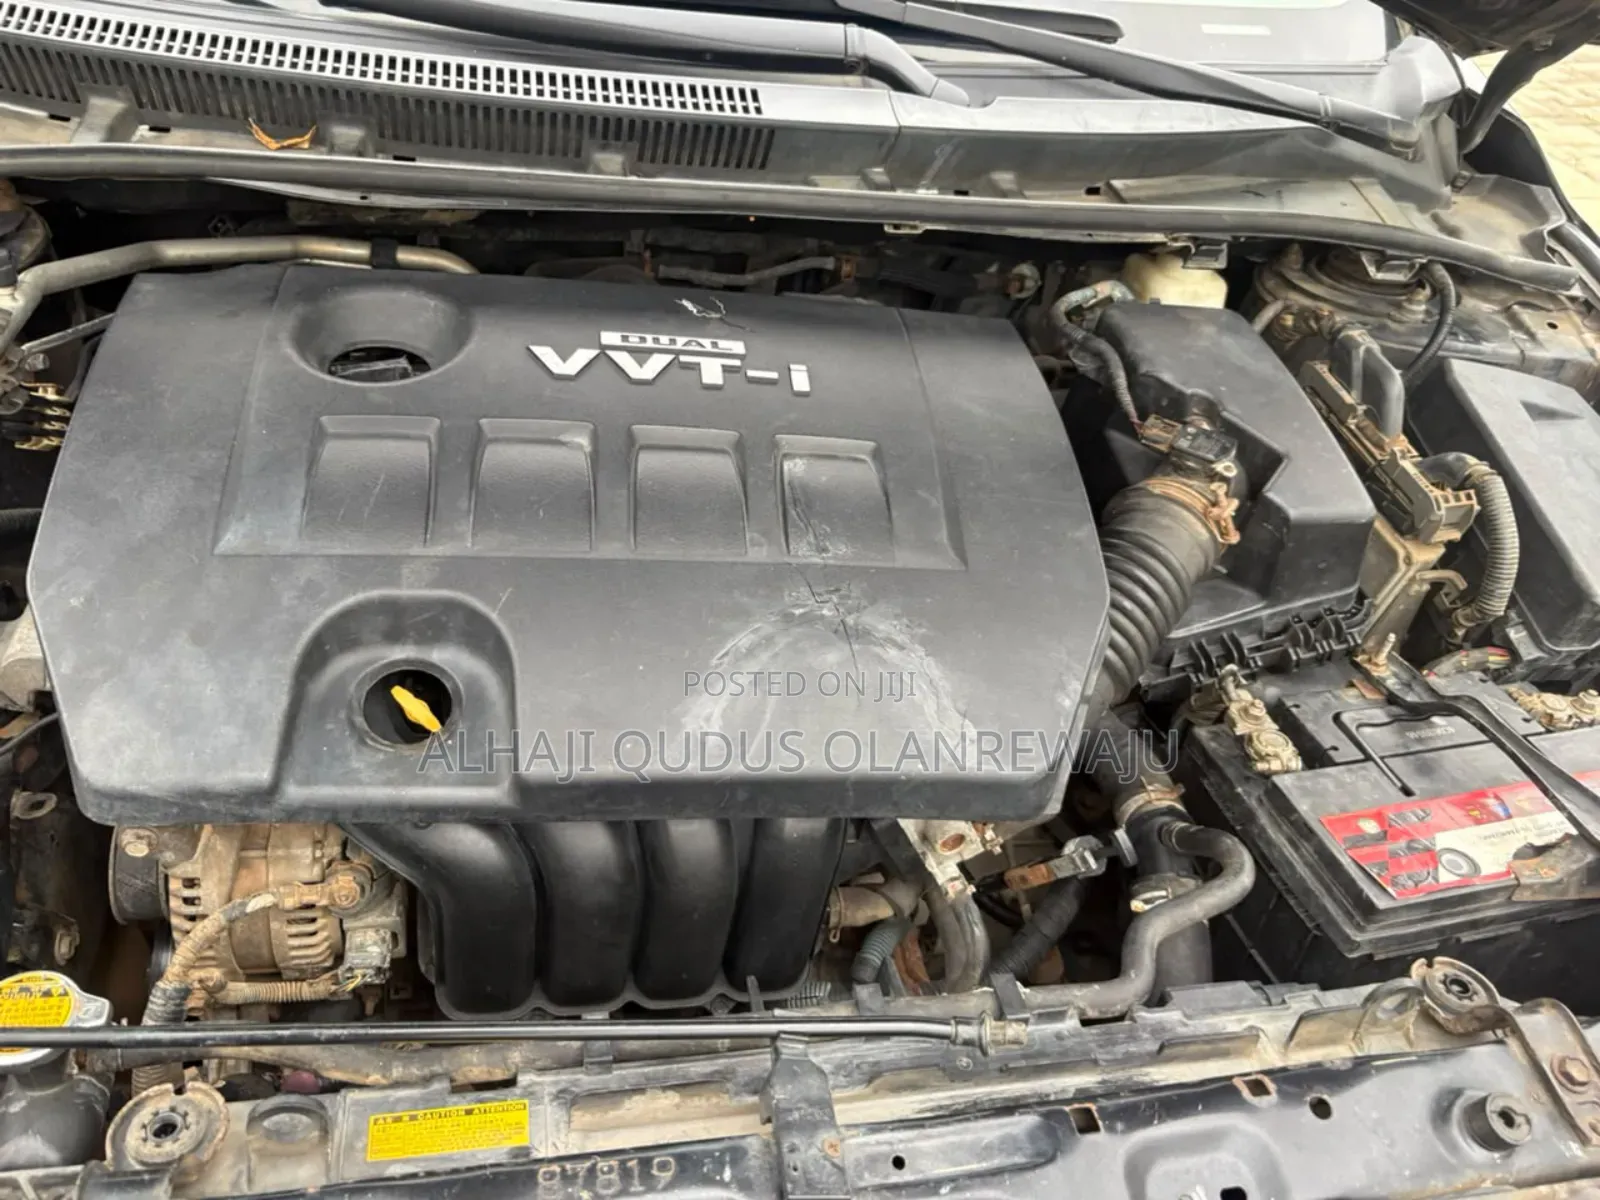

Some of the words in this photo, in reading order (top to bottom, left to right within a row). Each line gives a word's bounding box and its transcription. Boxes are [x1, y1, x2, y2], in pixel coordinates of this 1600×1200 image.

[619, 334, 734, 351] DUAL
[417, 1109, 466, 1121] CAUTION
[472, 1102, 525, 1115] ATTENTION
